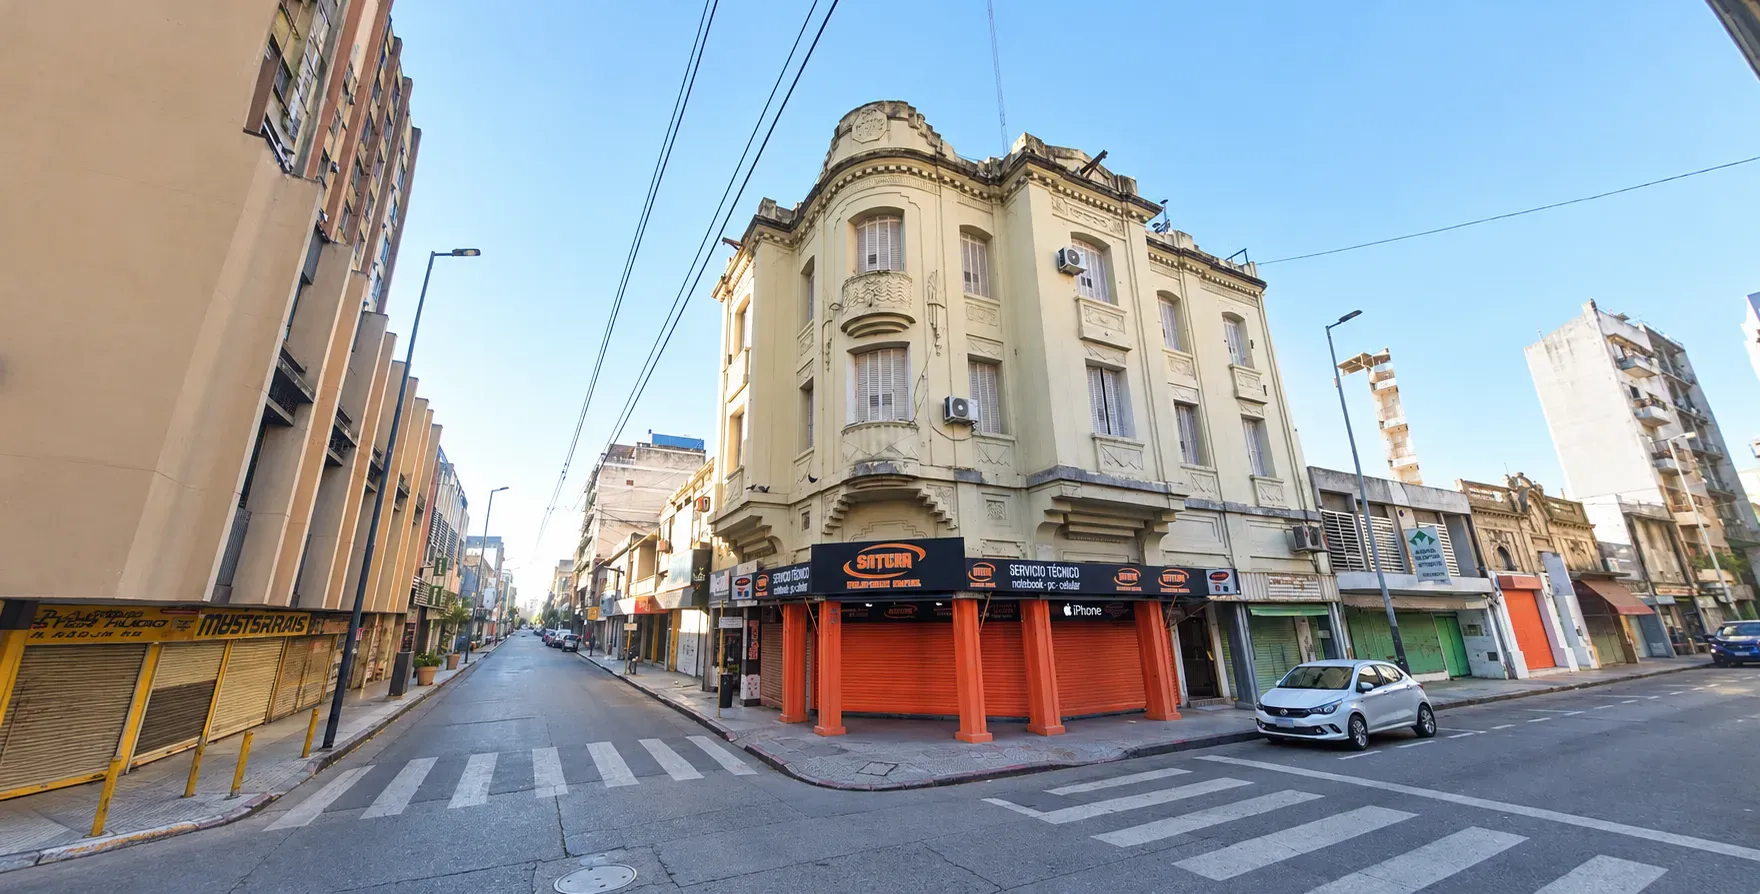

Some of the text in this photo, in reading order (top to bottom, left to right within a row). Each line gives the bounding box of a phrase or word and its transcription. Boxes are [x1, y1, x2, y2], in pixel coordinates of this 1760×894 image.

[1009, 563, 1046, 577] SERVICIO
[1047, 563, 1080, 579] TÉCNICO
[1073, 603, 1102, 616] iPhone
